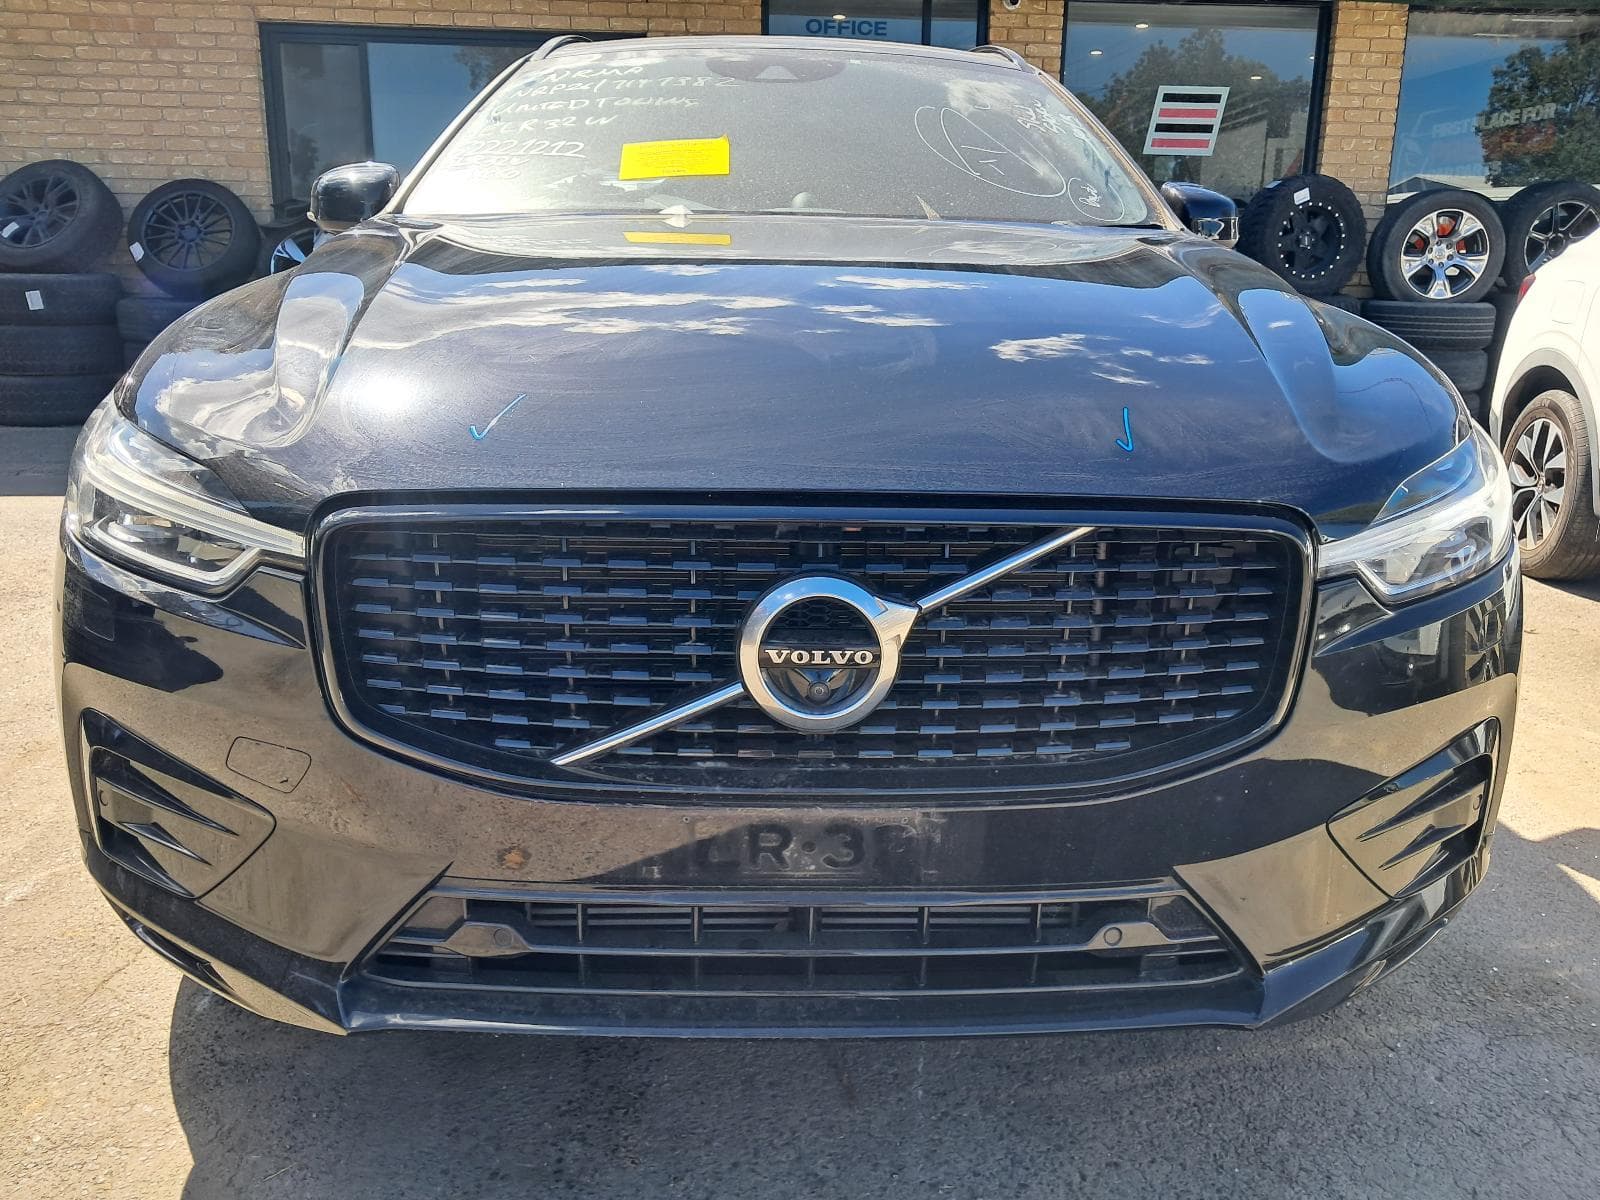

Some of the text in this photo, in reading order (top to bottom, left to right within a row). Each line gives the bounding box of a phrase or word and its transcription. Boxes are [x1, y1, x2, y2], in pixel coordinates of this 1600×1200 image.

[805, 18, 887, 36] OFFICE
[1521, 102, 1556, 122] FOR
[765, 649, 874, 665] VOLVO
